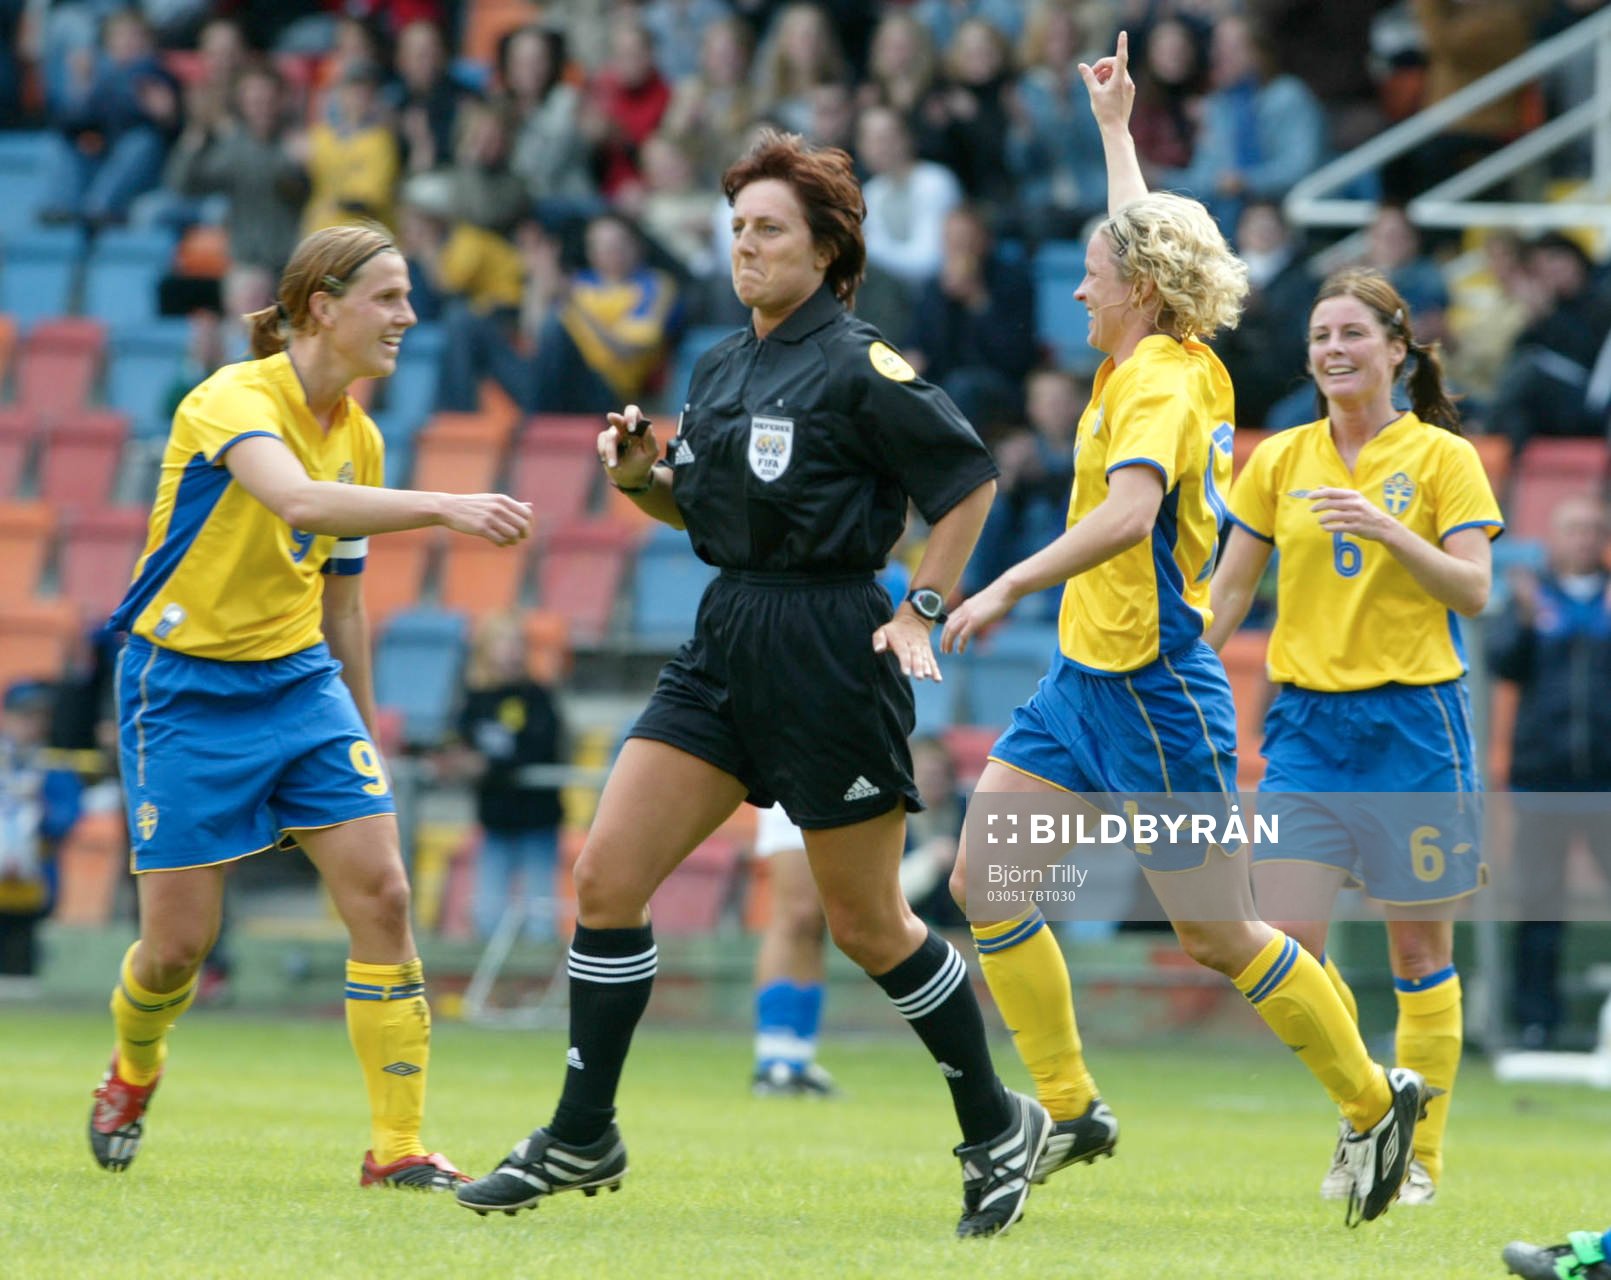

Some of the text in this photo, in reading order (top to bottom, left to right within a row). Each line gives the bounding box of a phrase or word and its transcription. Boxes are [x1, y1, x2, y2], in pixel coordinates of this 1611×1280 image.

[758, 458, 779, 469] FIFA
[1333, 531, 1362, 577] 6
[349, 740, 388, 795] 9
[1410, 825, 1445, 882] 6
